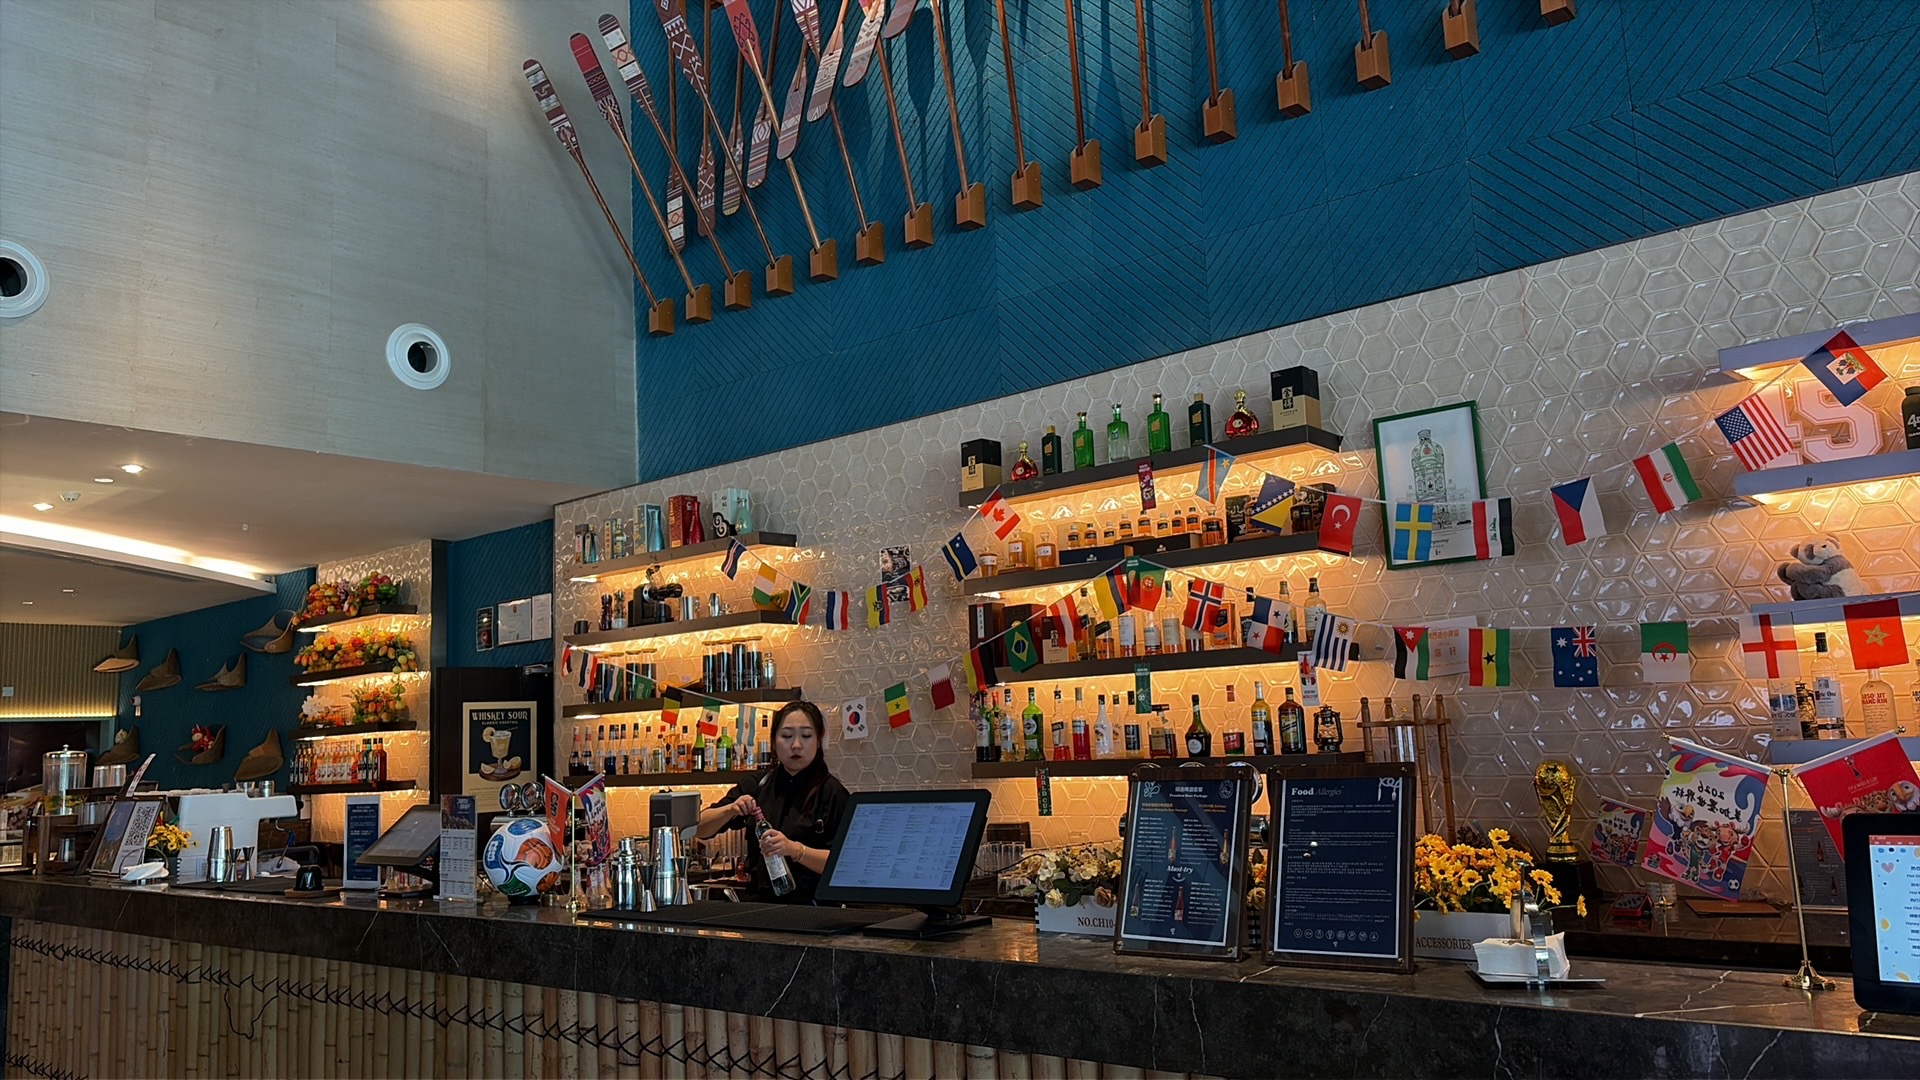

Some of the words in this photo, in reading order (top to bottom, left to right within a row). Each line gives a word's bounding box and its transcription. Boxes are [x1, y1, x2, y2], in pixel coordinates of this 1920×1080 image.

[471, 710, 506, 721] WHISKEY
[507, 710, 529, 721] SOUR
[1290, 787, 1314, 796] Food
[1315, 787, 1342, 797] Allergies
[1166, 865, 1194, 874] Must-try
[1415, 937, 1472, 950] ACCESSORIES
